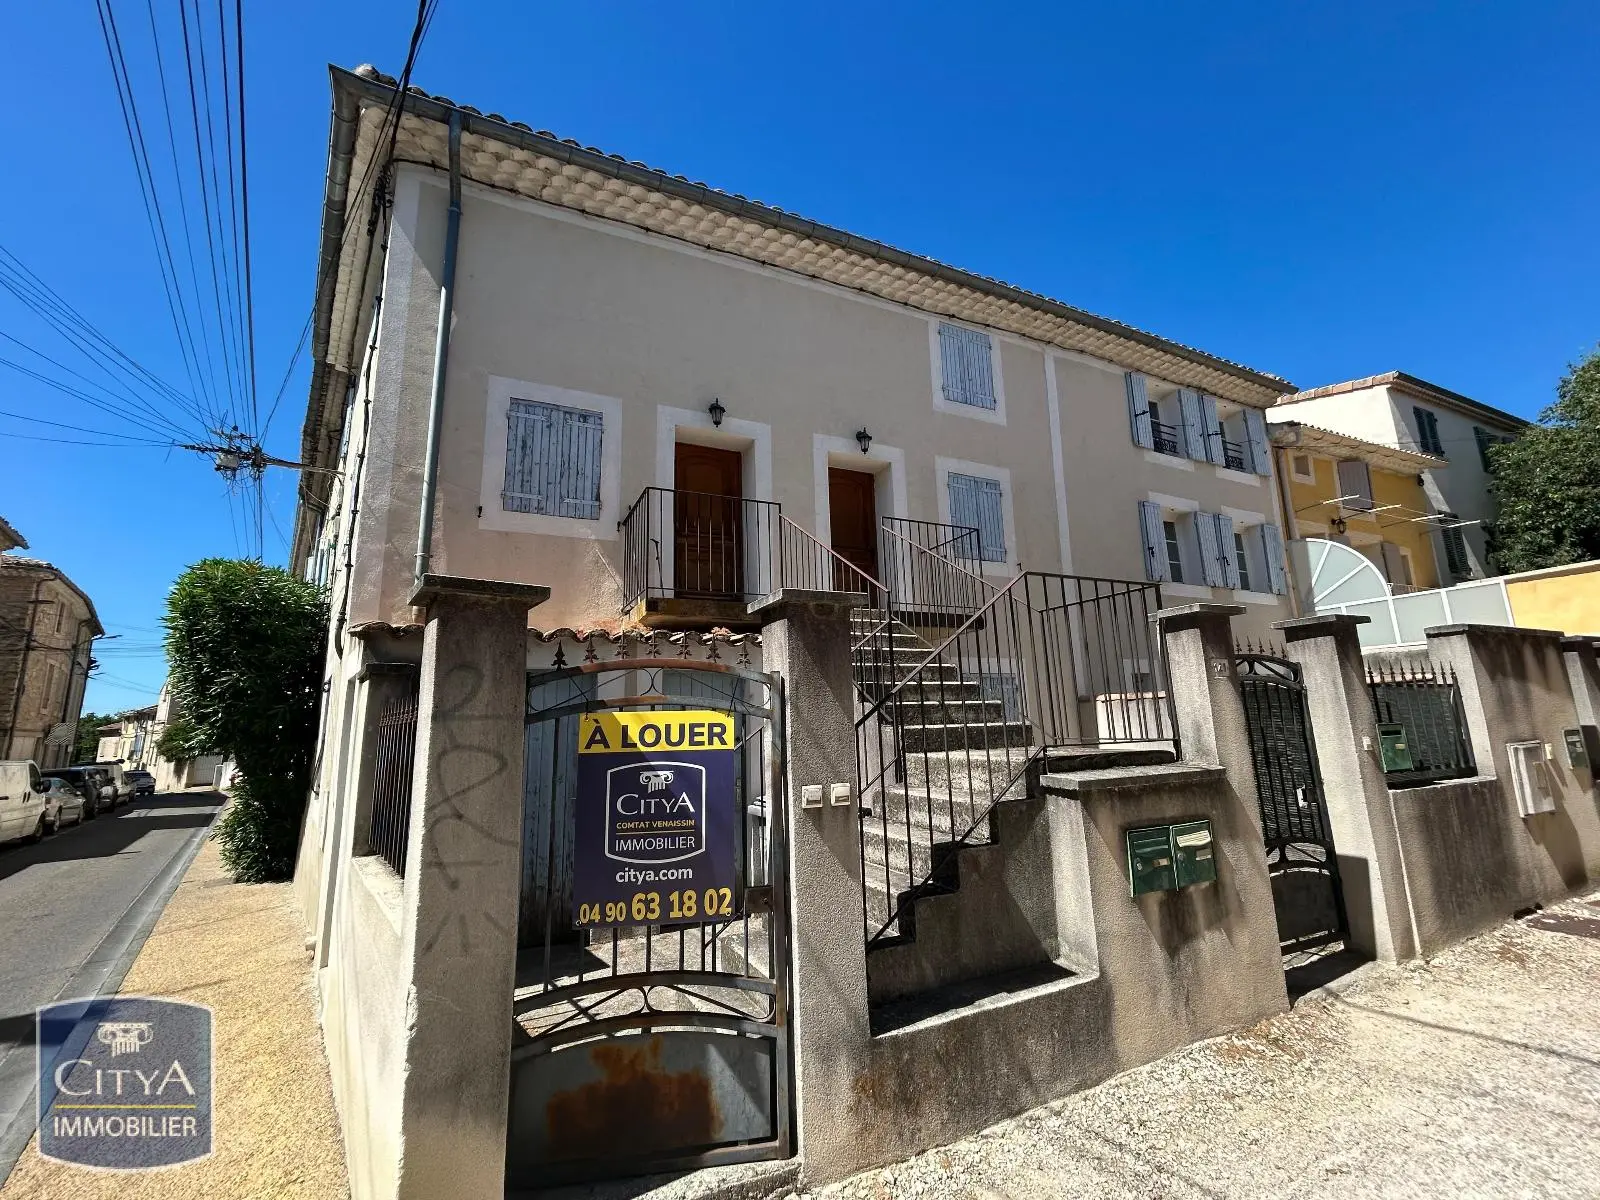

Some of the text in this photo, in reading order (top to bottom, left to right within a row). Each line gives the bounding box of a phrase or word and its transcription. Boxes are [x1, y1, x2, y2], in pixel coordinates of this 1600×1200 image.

[584, 718, 728, 750] À LOUER
[616, 819, 695, 830] COMTAT VENAISSIN
[615, 836, 695, 852] IMMOBILIER
[615, 867, 693, 885] citya.com
[579, 887, 732, 925] 04 90 63 18 02
